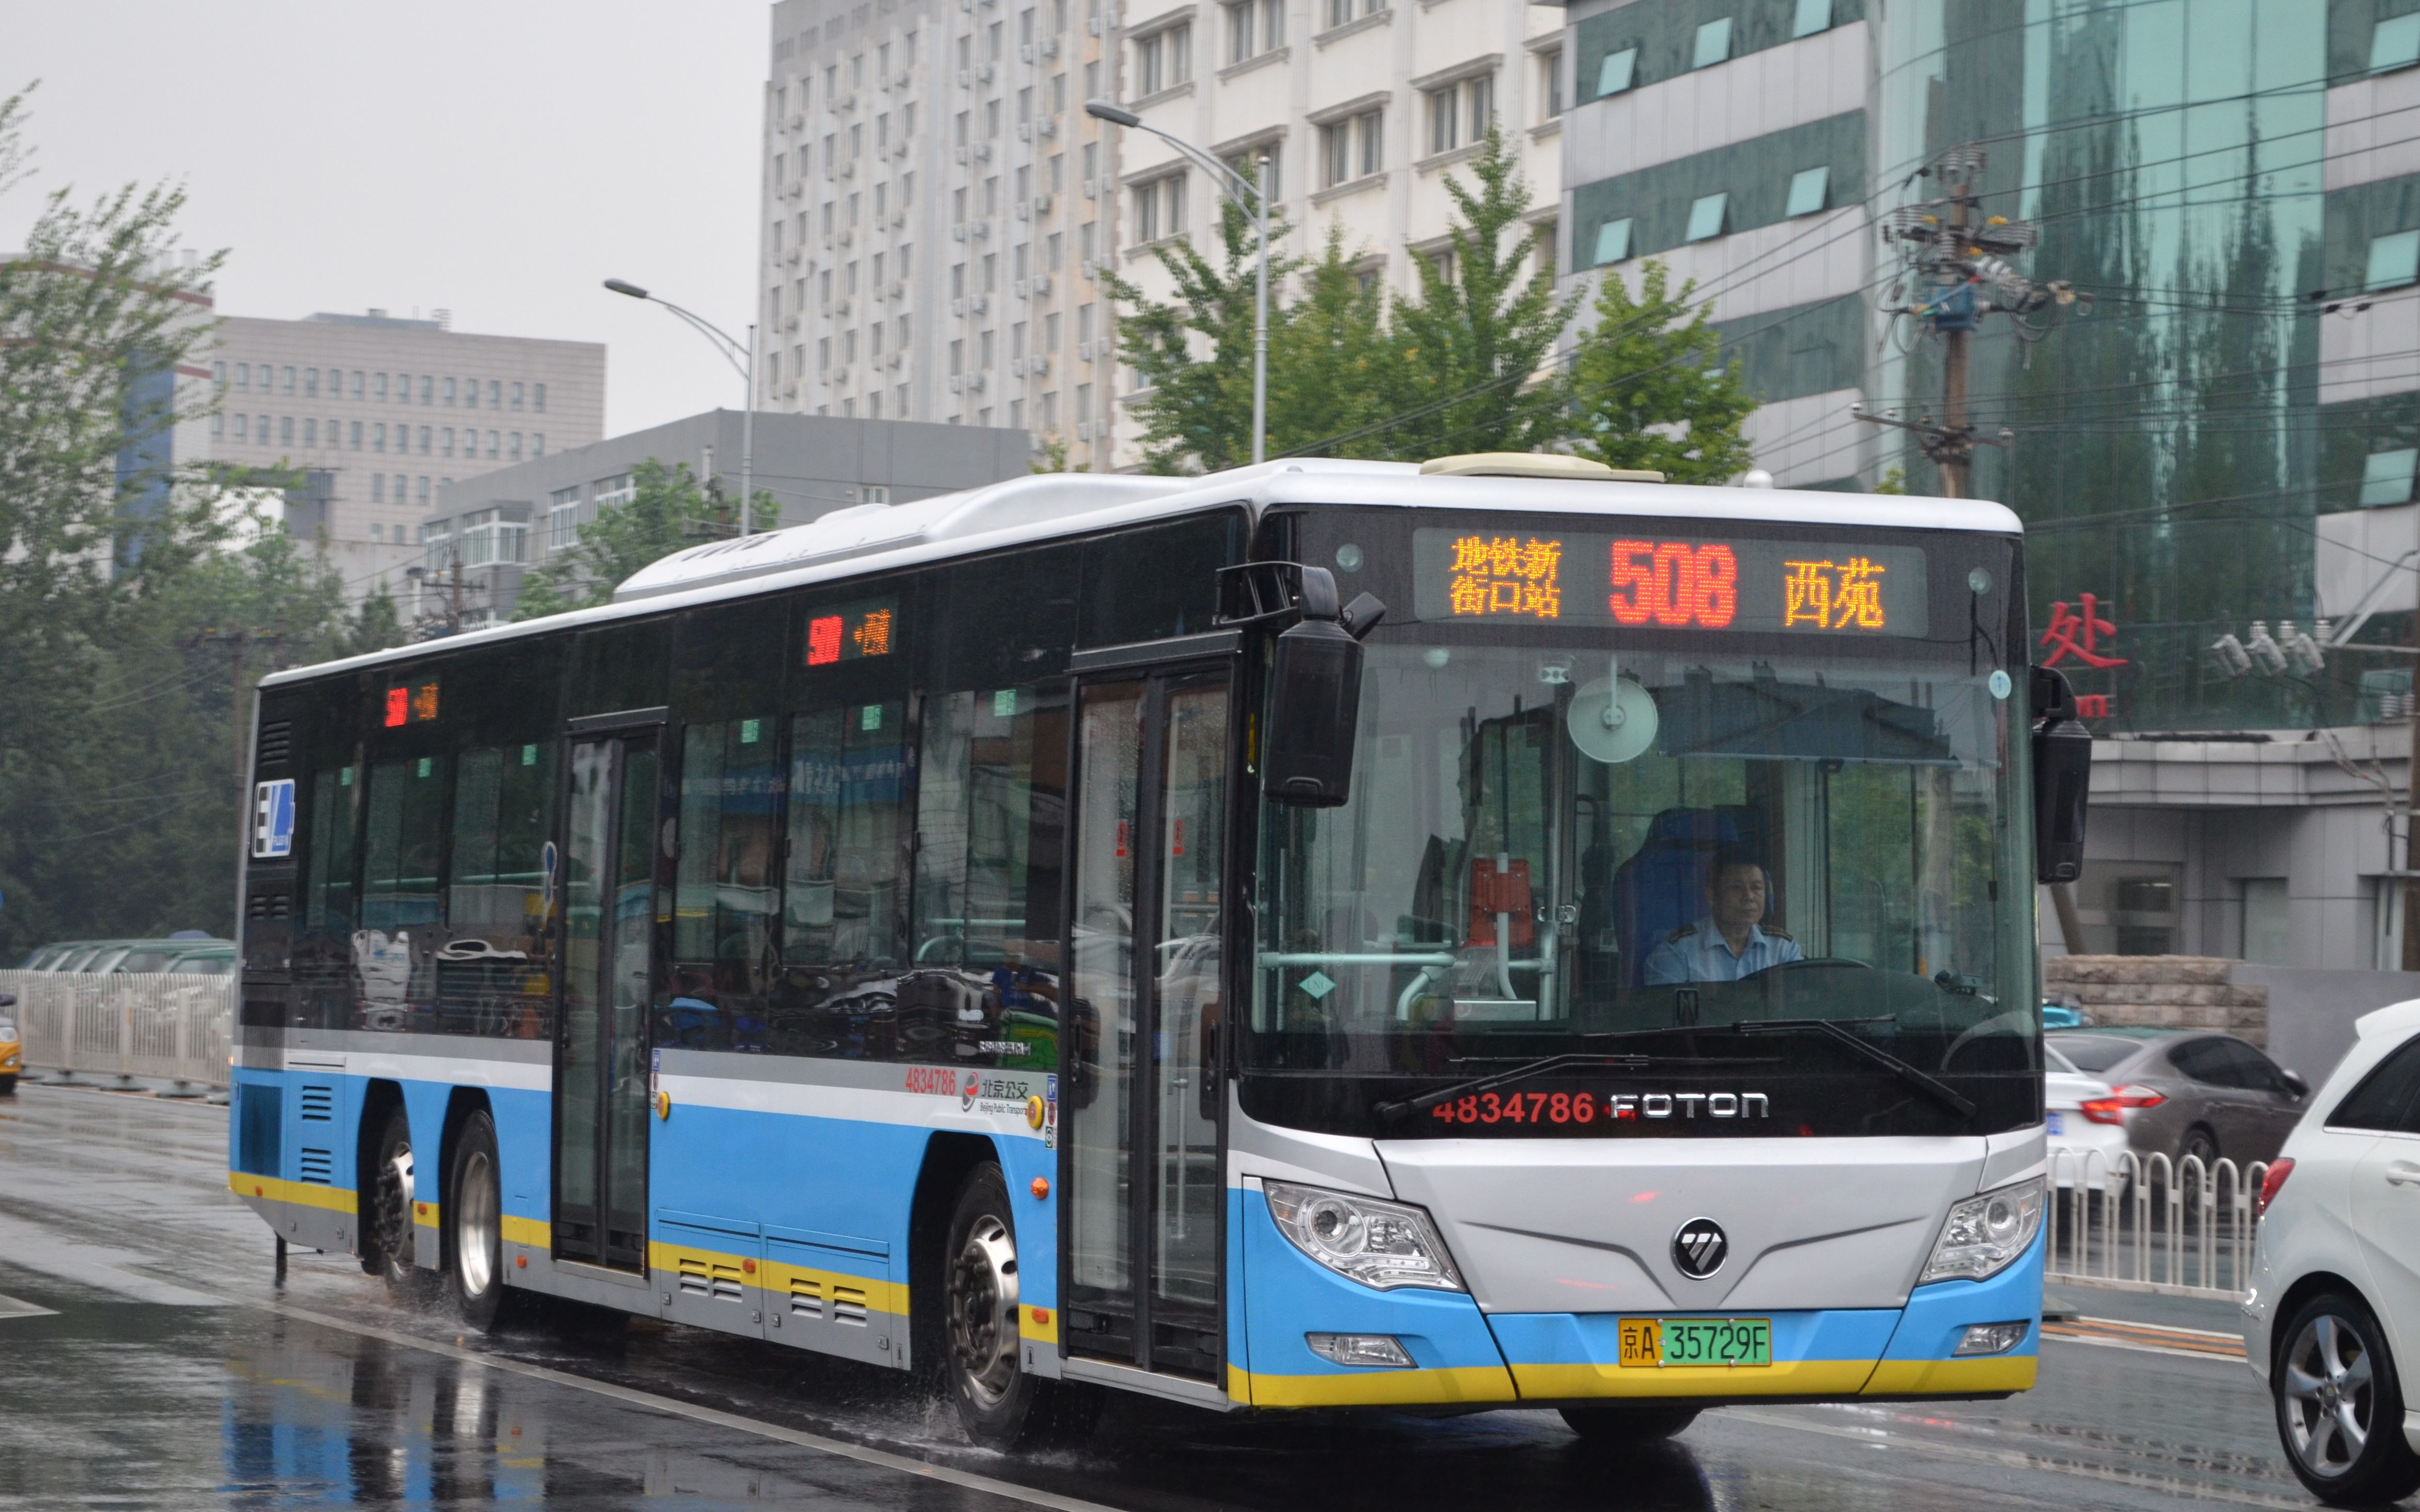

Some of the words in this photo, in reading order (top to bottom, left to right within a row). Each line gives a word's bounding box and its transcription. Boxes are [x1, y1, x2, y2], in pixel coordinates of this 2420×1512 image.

[1450, 536, 1561, 579] 地铁新
[1450, 577, 1561, 618] 街口站
[1610, 540, 1737, 627] 508
[1785, 557, 1885, 629] 西苑
[905, 1068, 956, 1096] 4834786
[982, 1079, 1029, 1100] 北京公交
[980, 1102, 993, 1115] Beijing
[994, 1103, 1006, 1115] Public
[1432, 1092, 1594, 1123] 4834786
[1610, 1093, 1768, 1119] FOTON
[1623, 1326, 1655, 1359] 京A
[1670, 1325, 1767, 1360] 35729F
